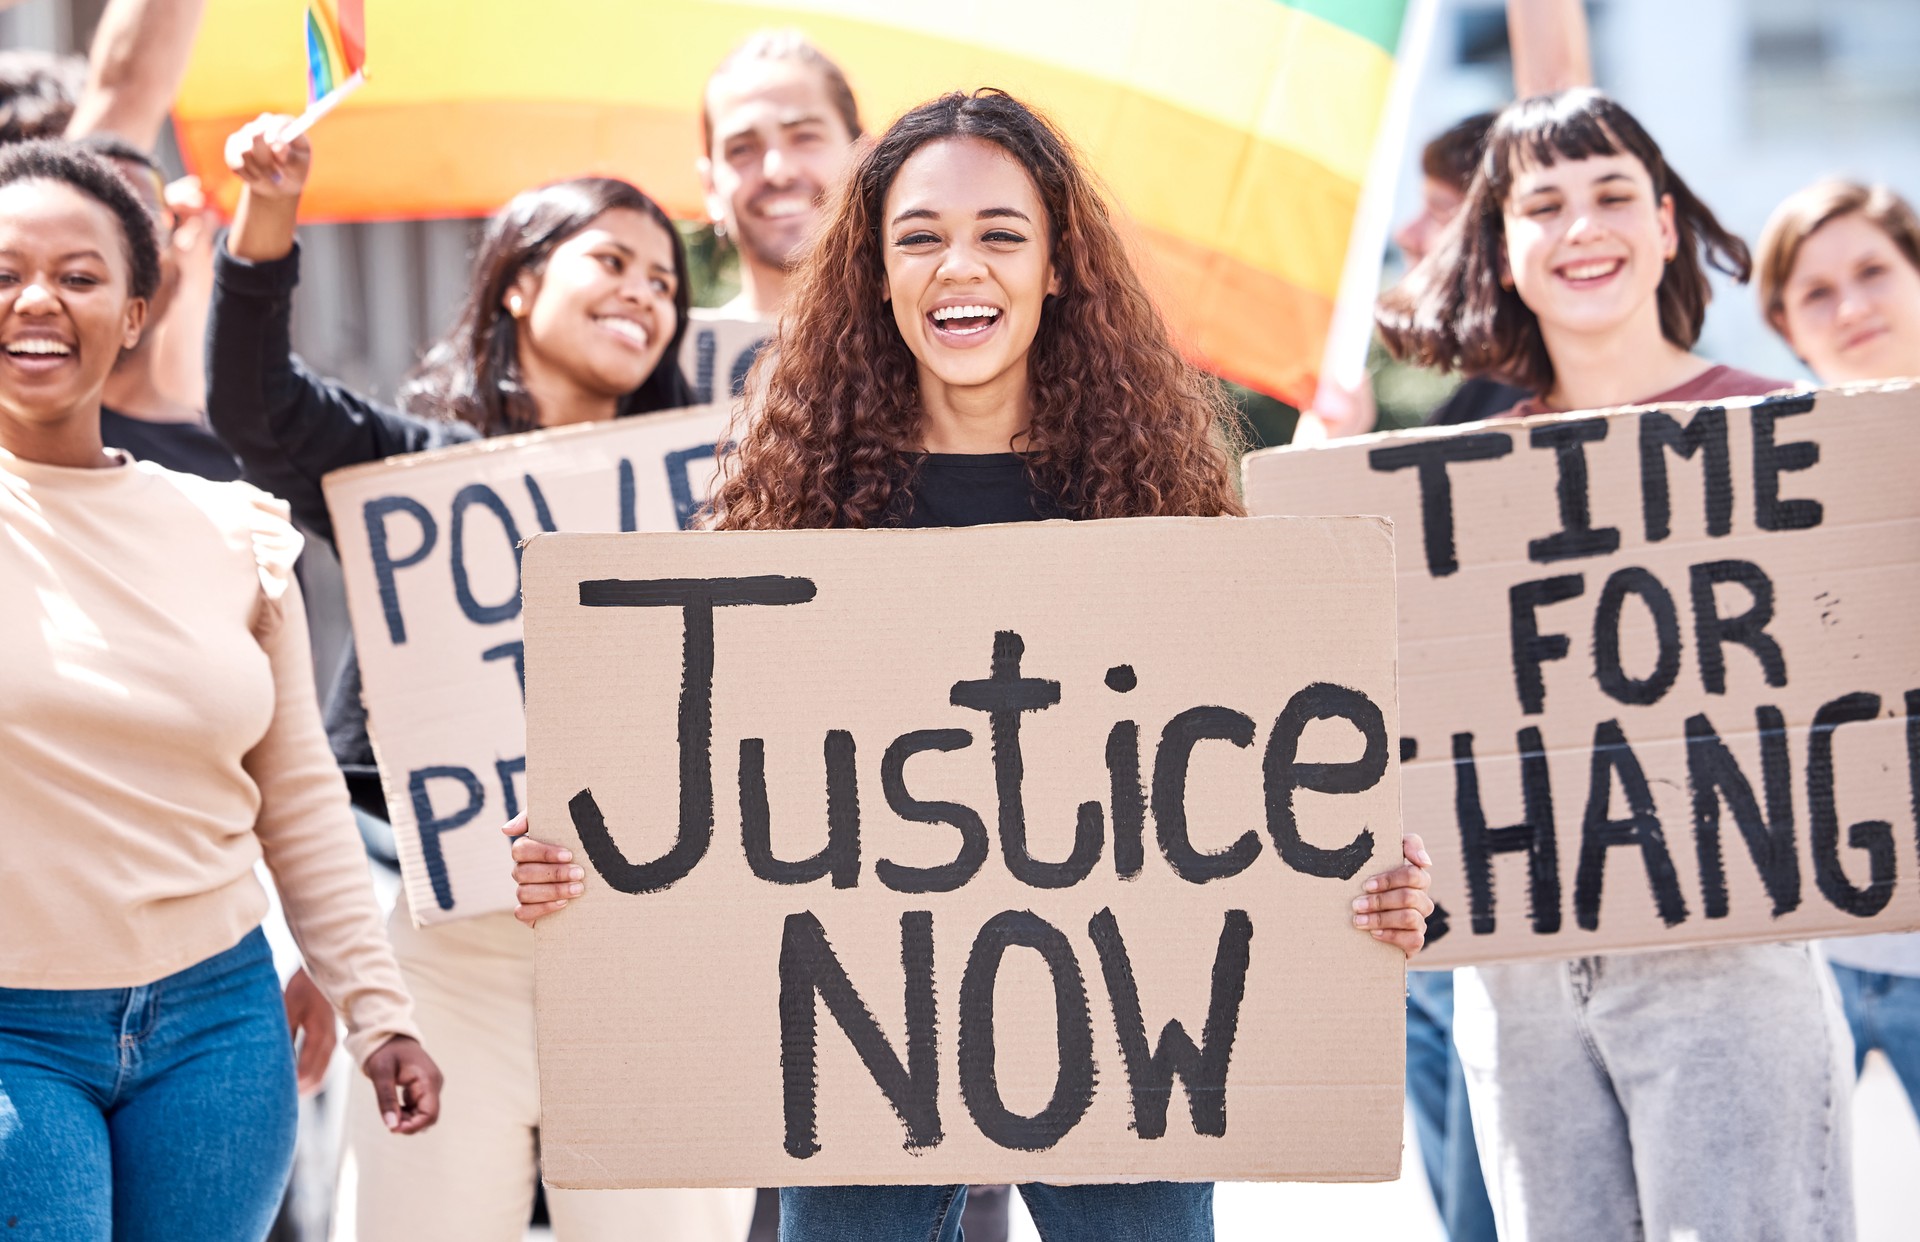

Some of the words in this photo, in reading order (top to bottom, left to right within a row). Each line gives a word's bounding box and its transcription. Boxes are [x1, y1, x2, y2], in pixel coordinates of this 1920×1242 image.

[1369, 394, 1824, 577] TIME
[568, 575, 1390, 894] Justice
[1508, 558, 1788, 715] FOR
[1400, 688, 1920, 950] HANG
[778, 906, 1254, 1160] NOW
